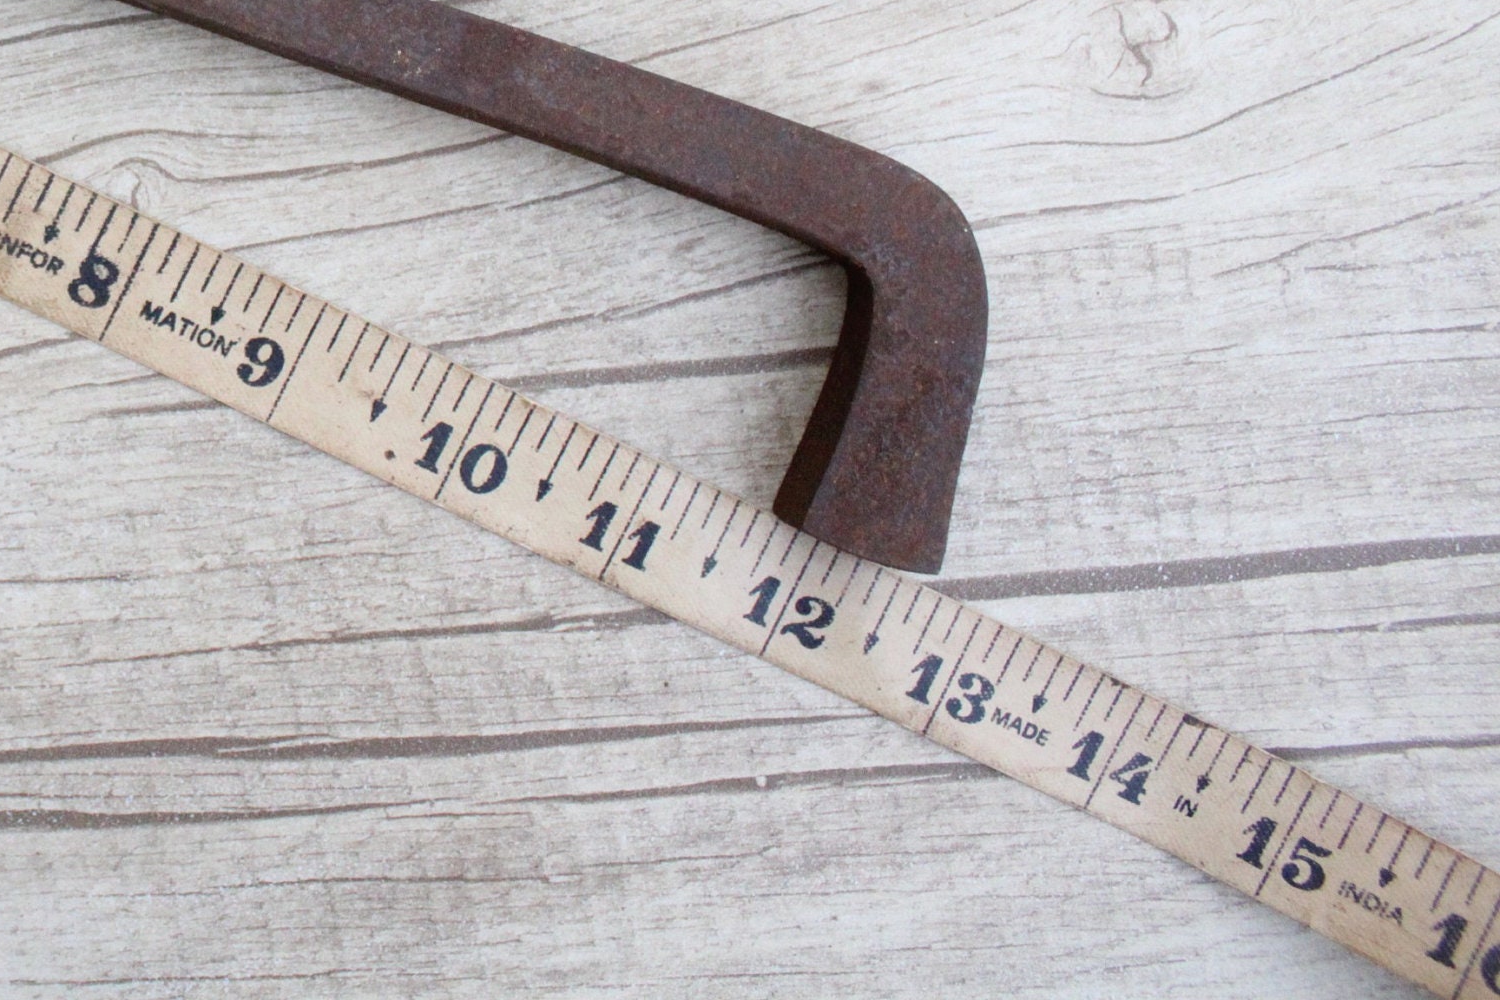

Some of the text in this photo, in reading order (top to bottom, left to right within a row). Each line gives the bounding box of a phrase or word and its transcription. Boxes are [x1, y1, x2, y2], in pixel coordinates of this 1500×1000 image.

[67, 254, 120, 308] 8
[140, 301, 238, 357] MATION
[236, 336, 286, 388] 9
[414, 421, 508, 495] 10
[579, 501, 662, 572] 11
[741, 576, 837, 650] 12
[904, 653, 997, 726] 13
[991, 704, 1052, 747] MADE
[1065, 729, 1153, 806] 14
[1172, 794, 1200, 819] IN
[1235, 816, 1333, 891] 15
[1337, 880, 1403, 926] INDIA
